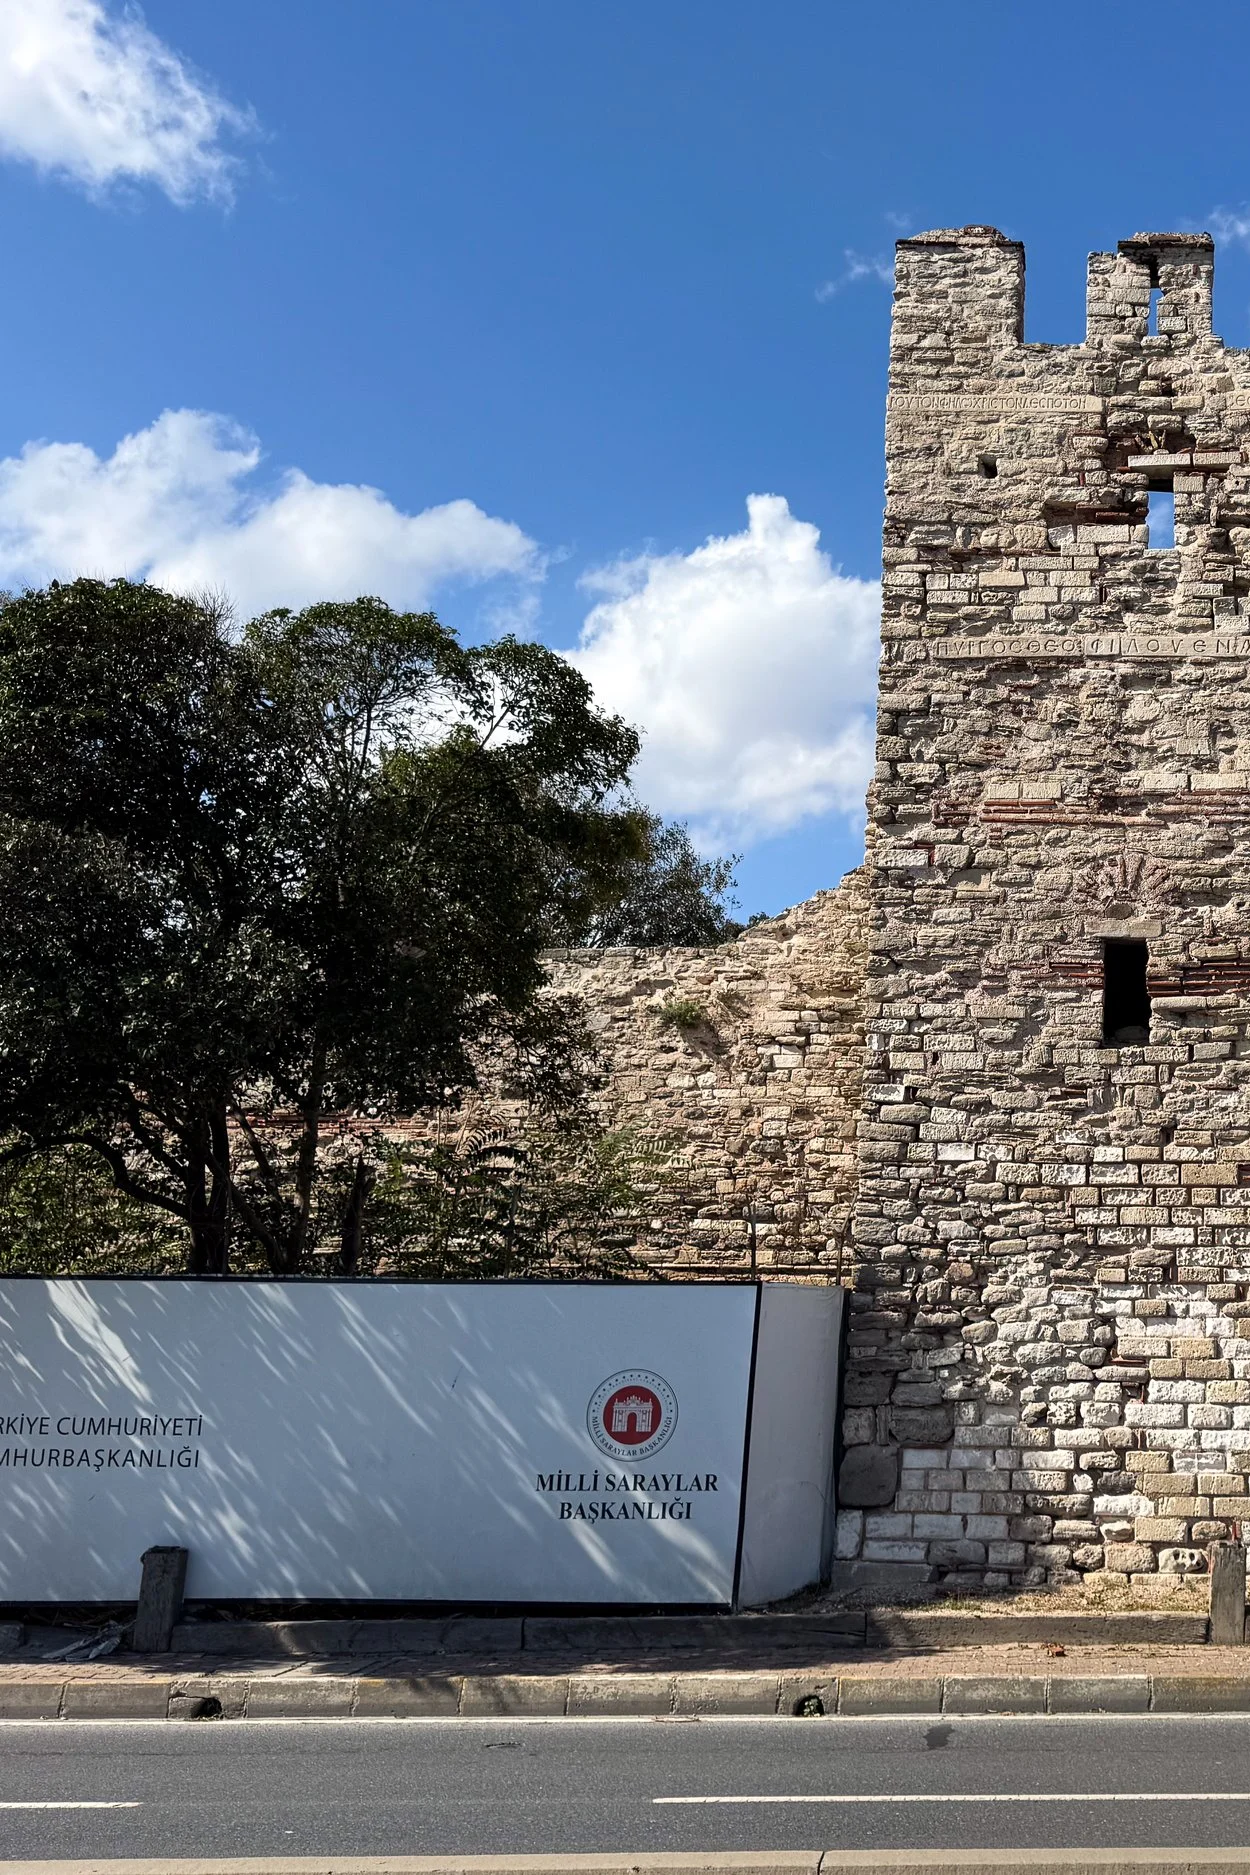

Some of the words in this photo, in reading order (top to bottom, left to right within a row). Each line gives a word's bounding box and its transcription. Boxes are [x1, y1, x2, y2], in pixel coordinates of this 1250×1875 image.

[56, 1414, 203, 1436] CUMHURİYETİ
[600, 1437, 637, 1456] SARAYLAR
[640, 1416, 673, 1455] BAŞKANLIĞI
[536, 1470, 599, 1491] MİLLİ
[605, 1473, 718, 1492] SARAYLAR
[559, 1496, 692, 1524] BAŞKANLIĞI
